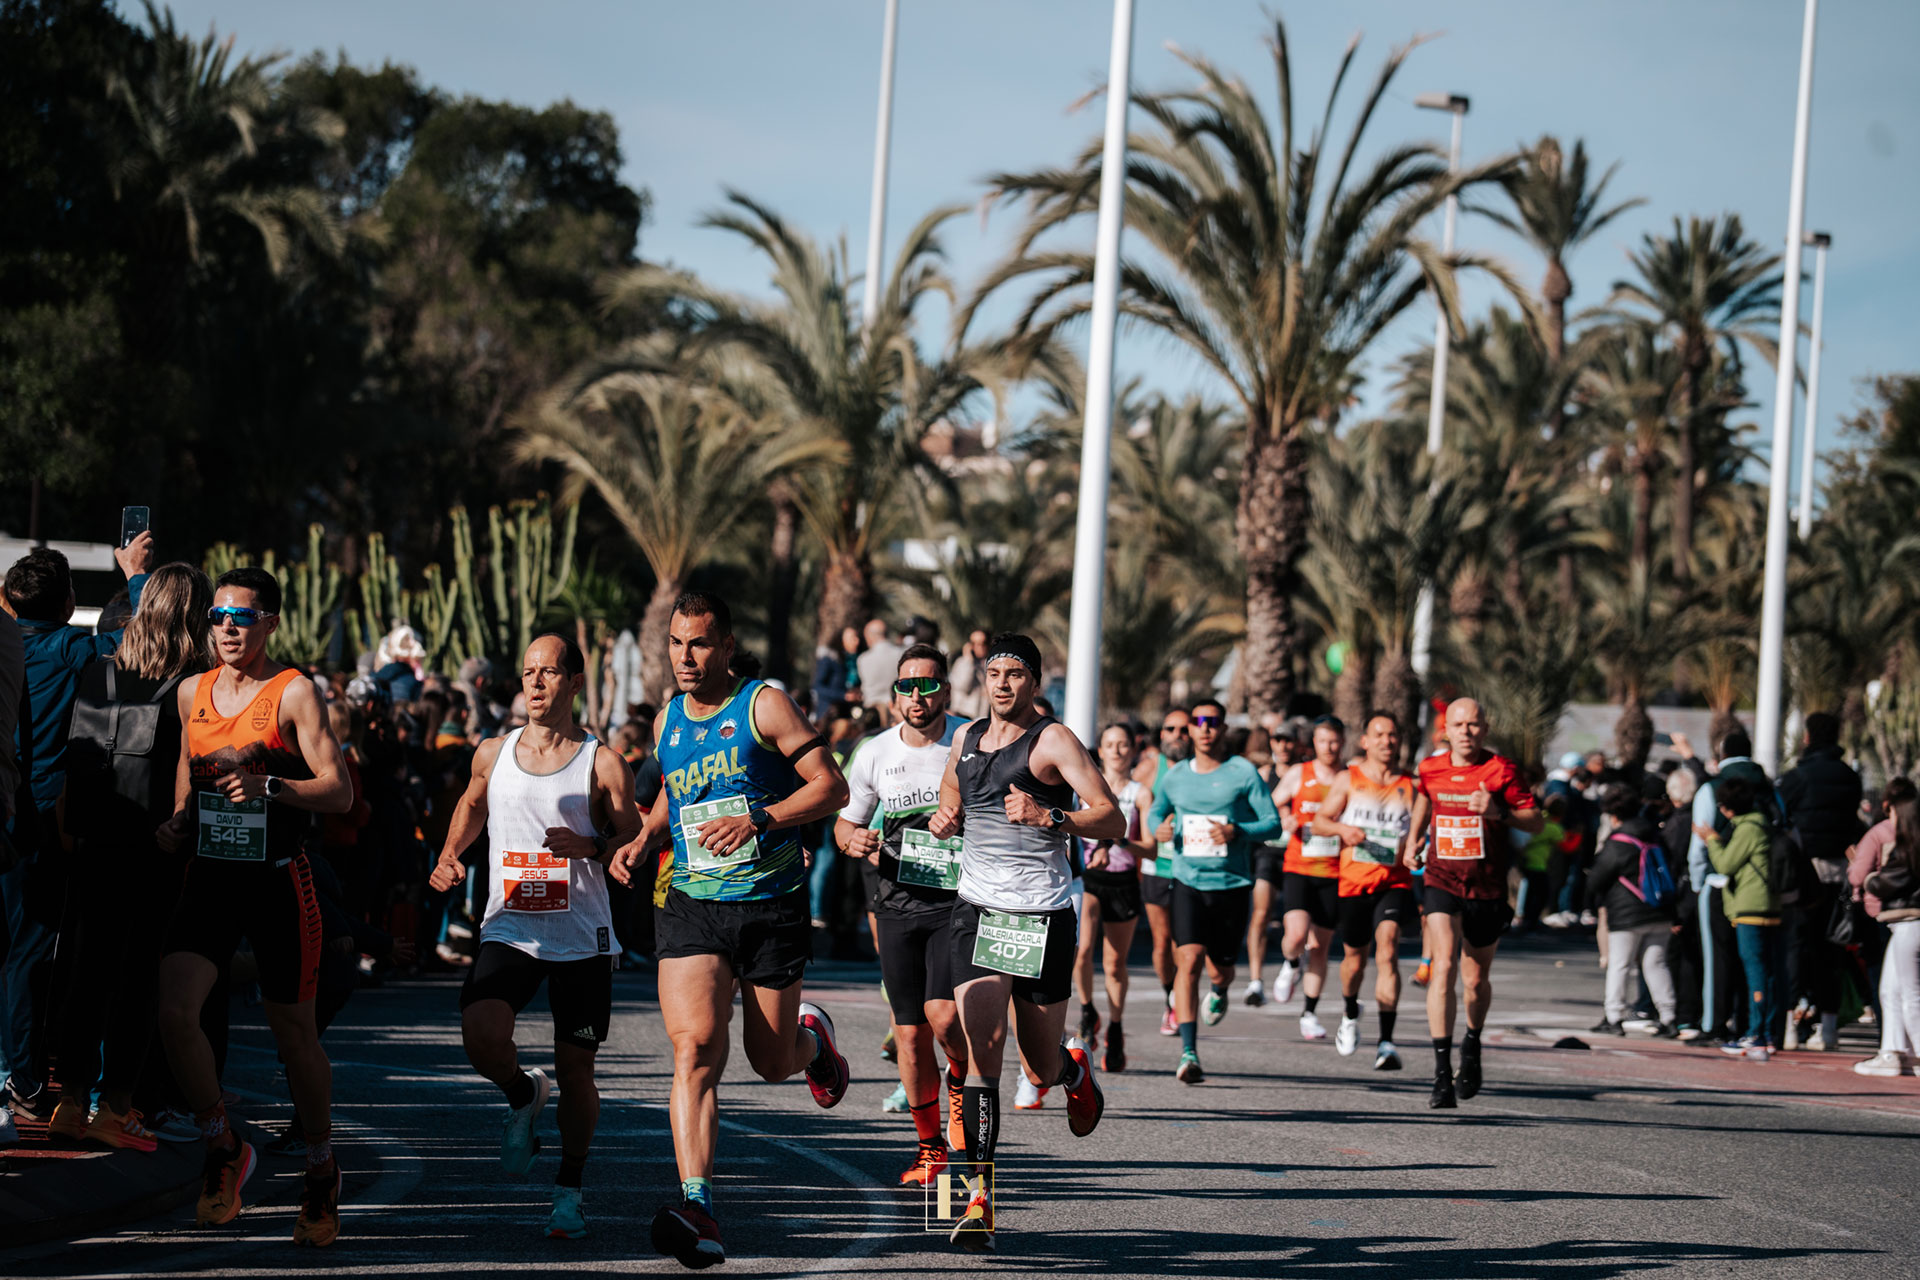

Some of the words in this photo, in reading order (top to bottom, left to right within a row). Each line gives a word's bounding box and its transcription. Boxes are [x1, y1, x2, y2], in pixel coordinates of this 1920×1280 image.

[666, 746, 747, 800] RAFAL
[216, 813, 243, 826] DAVID
[210, 826, 251, 845] 545
[1451, 837, 1466, 849] 12
[920, 847, 944, 859] DAVID
[519, 869, 549, 880] JESUS
[912, 858, 948, 876] 475
[520, 882, 547, 898] 93
[981, 926, 1042, 945] VALERIA/CARLA
[988, 941, 1031, 961] 407
